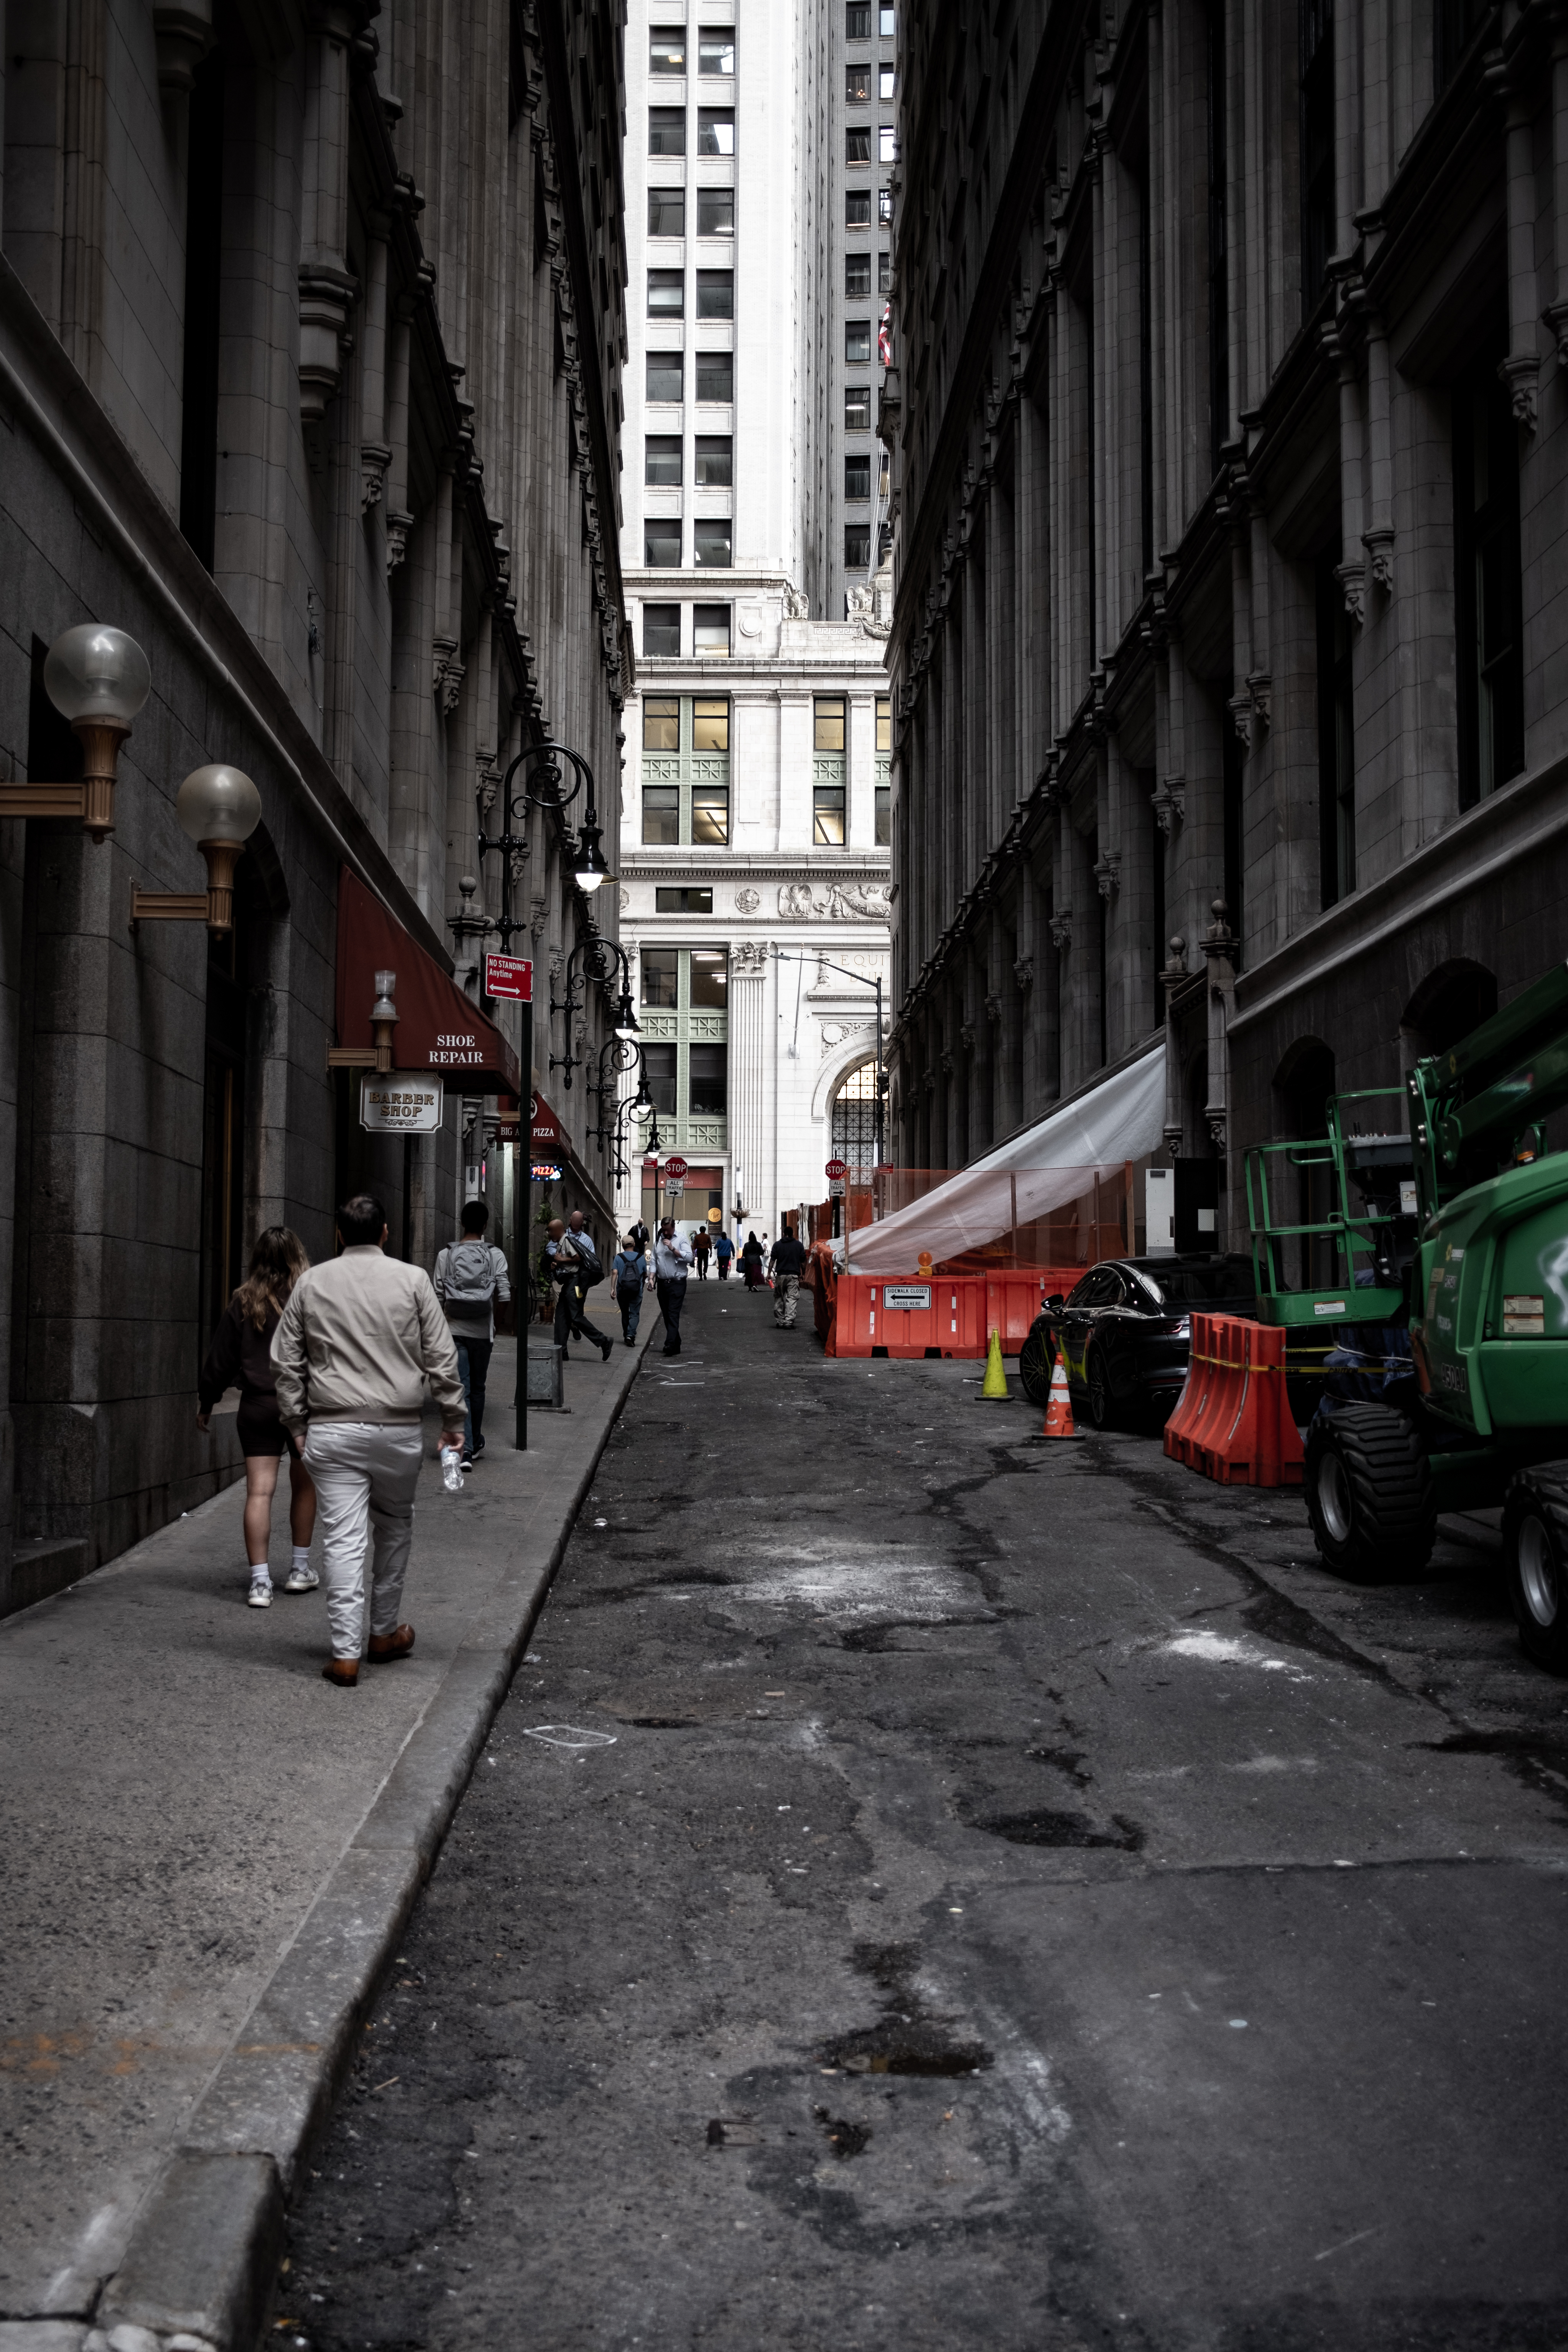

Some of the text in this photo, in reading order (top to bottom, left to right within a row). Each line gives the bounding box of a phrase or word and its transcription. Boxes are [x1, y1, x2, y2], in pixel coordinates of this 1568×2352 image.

[489, 958, 525, 972] NO STANDING
[489, 968, 512, 978] Anytime
[437, 1035, 475, 1046] SHOE
[429, 1051, 484, 1063] REPAIR
[369, 1092, 434, 1105] BARBER
[380, 1105, 422, 1117] SHOP
[500, 1127, 554, 1137] BIG A PIZZA
[666, 1164, 686, 1172] STOP
[826, 1166, 845, 1174] STOP
